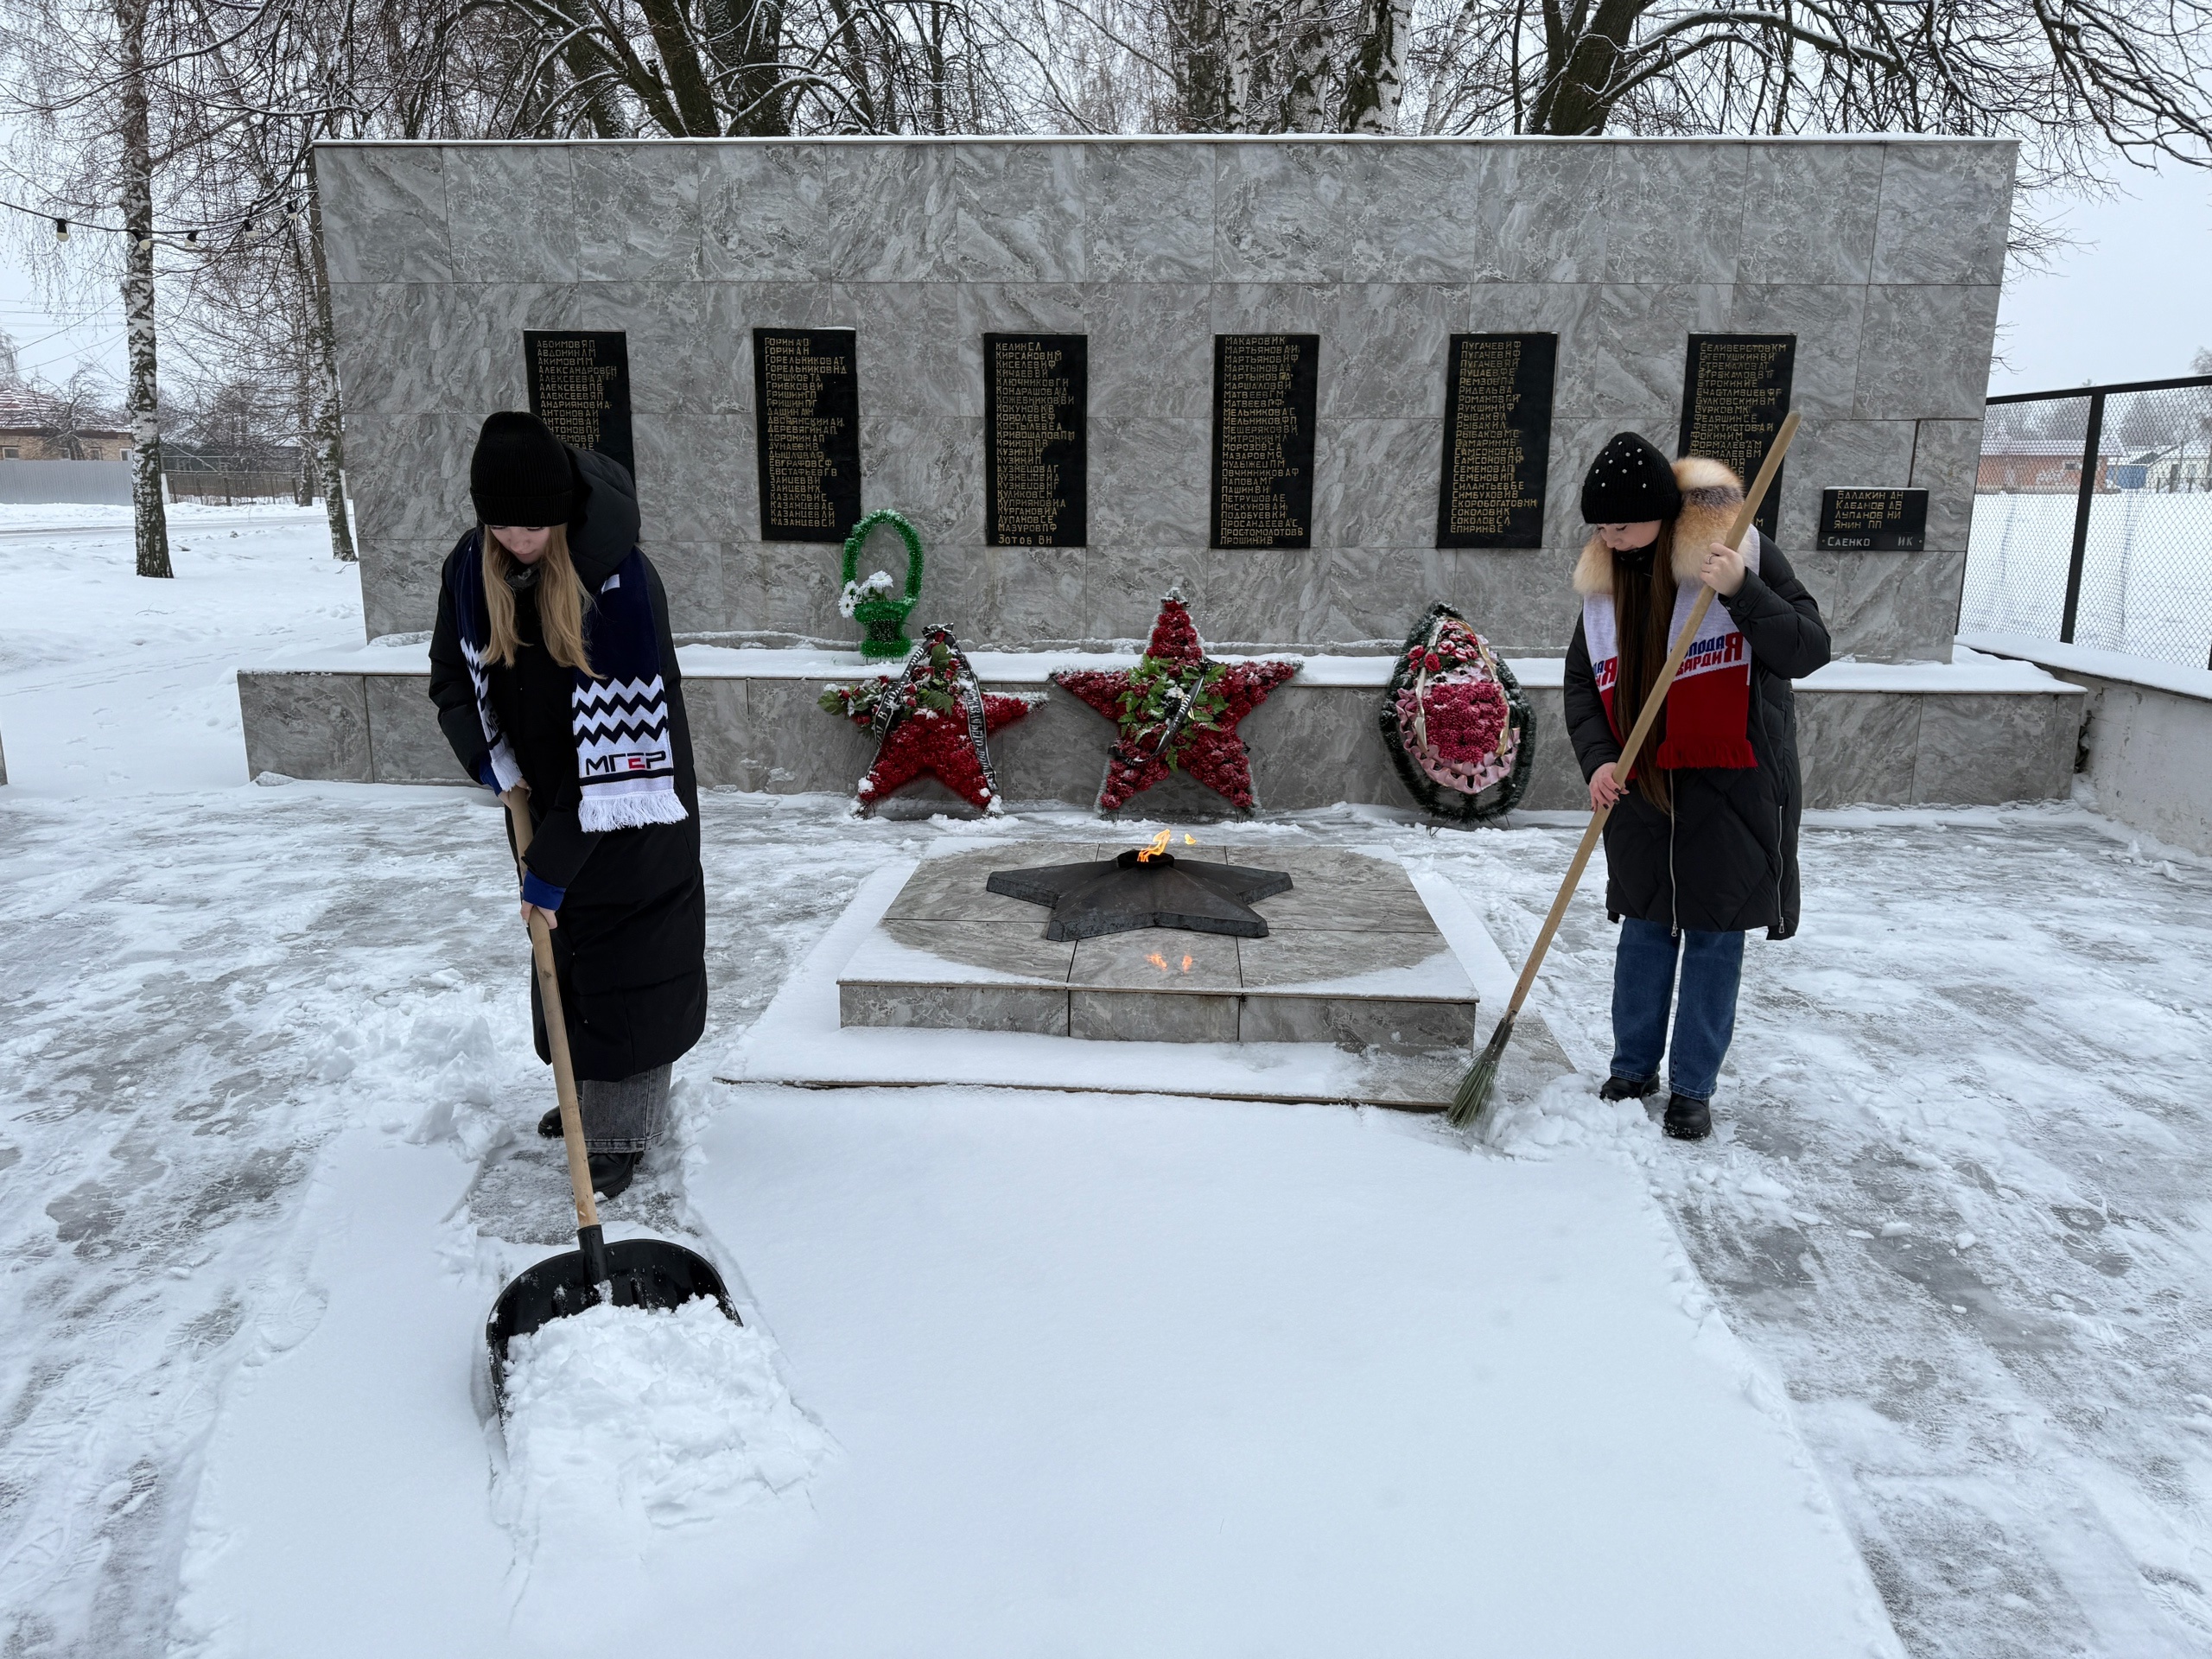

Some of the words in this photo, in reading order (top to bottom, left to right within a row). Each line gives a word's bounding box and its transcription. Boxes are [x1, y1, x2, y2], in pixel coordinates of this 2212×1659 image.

[537, 340, 580, 348] АБОИМОВ
[1225, 337, 1270, 346] МАКАРОВ
[1461, 341, 1503, 350] ПУГАЧЕВ
[765, 346, 794, 355] ГОРИН
[995, 342, 1027, 351] КЕЛИН
[1224, 346, 1282, 354] МАРТЬЯНОВ
[537, 348, 580, 357] АВДОНИН
[995, 351, 1045, 360] КИРСАНОВ
[1461, 350, 1503, 359] ПУГАЧЕВ
[538, 357, 575, 365] АКИМОВ
[765, 355, 831, 365] ГОРЕЛЬНИКОВ
[995, 360, 1039, 369] КИСЕЛЕВ
[1460, 359, 1503, 368] ПУГАЧЕВ
[538, 365, 605, 374] АЛЕКСАНДРОВ
[766, 364, 831, 373] ГОРЕЛЬНИКОВ
[1224, 364, 1278, 372] МАРТЫНОВ
[539, 374, 588, 383] АЛЕКСЕЕВ
[766, 372, 808, 381] ГОРШКОВ
[766, 381, 808, 391] ГРИБКОВ
[996, 378, 1054, 386] КЛЮЧНИКОВ
[539, 383, 588, 391] АЛЕКСЕЕВ
[996, 386, 1052, 396] КОНДРАШОВ
[540, 391, 588, 400] АЛЕКСЕЕВ
[1459, 395, 1504, 404] РОМАНОВ
[541, 400, 595, 409] АНДРИЯНОВ
[1224, 399, 1267, 408] МАТВЕЕВ
[1223, 408, 1281, 416] МЕЛЬНИКОВ
[996, 413, 1039, 422] КОРОЛЕВ
[1223, 416, 1280, 425] МЕЛЬНИКОВ
[767, 424, 822, 434] ДЕРЕВЯГИН
[996, 422, 1047, 430] КОСТЫЛЕВ
[768, 433, 810, 442] ДОРОНИН
[769, 467, 823, 476] ЕВСТАФЬЕВ
[1453, 464, 1499, 474] СЕМЕНОВ
[1453, 473, 1498, 482] СЕМЕНОВ
[997, 481, 1045, 490] КУЗНЕЦОВ
[770, 493, 813, 501] КАЗАКОВ
[997, 490, 1038, 499] КУЛИКОВ
[1838, 490, 1885, 499] БАЛАКИН
[771, 500, 820, 510] КАЗАНЦЕВ
[998, 498, 1052, 506] КУПРИЯНОВ
[771, 509, 820, 518] КАЗАНЦЕВ
[998, 506, 1043, 516] КУРГАНОВ
[771, 518, 820, 527] КАЗАНЦЕВ
[1451, 516, 1495, 524] СОКОЛОВ
[998, 524, 1041, 532] МАЗУРОВ
[1827, 537, 1871, 547] САЕНКО
[586, 750, 666, 776] МГЕР
